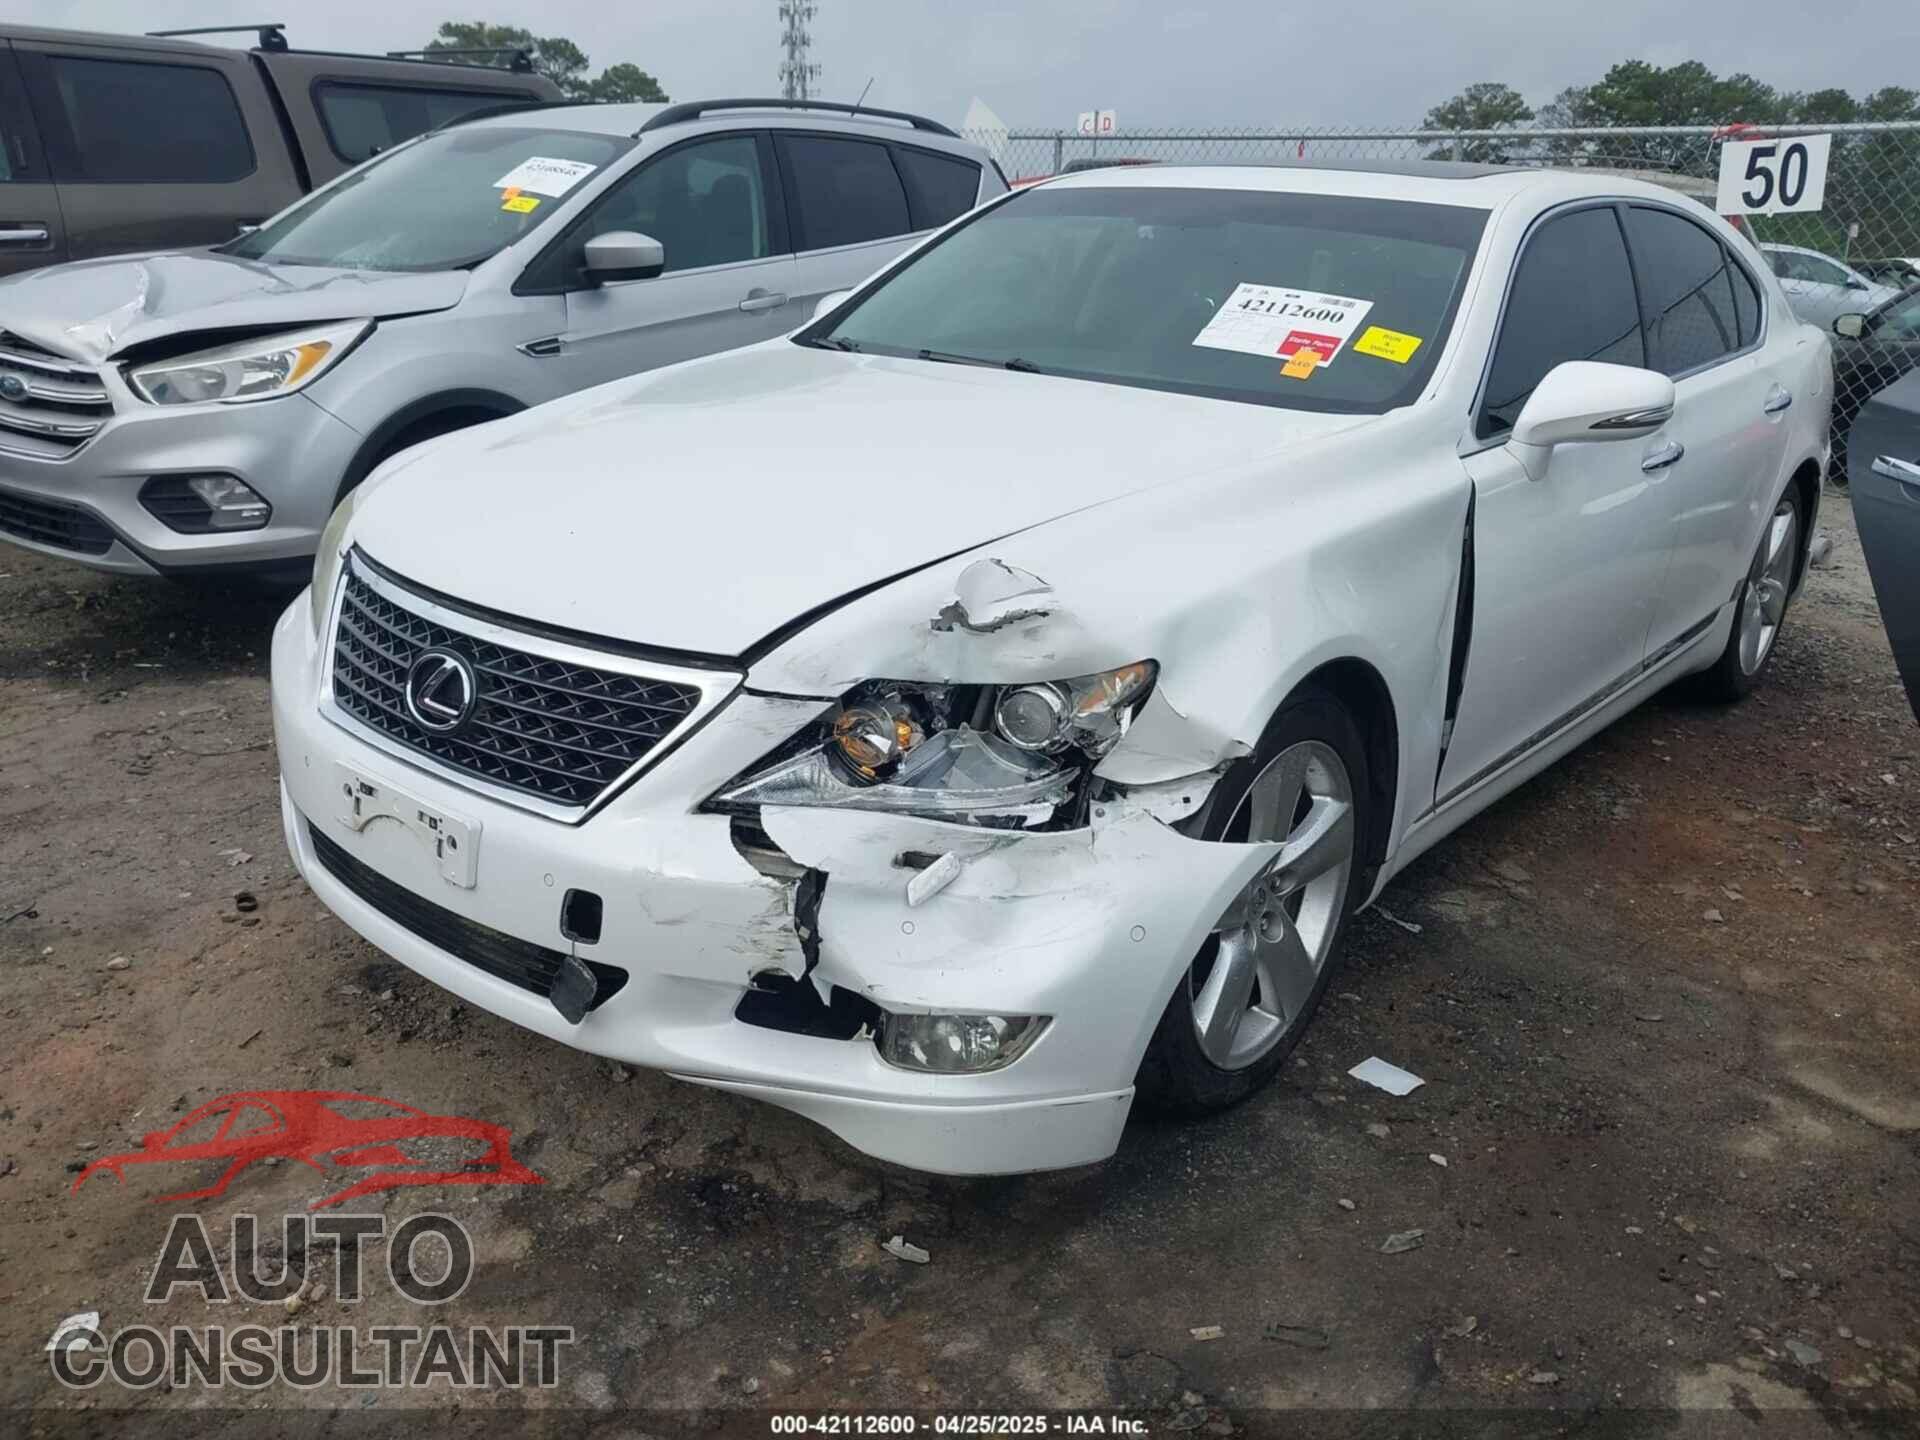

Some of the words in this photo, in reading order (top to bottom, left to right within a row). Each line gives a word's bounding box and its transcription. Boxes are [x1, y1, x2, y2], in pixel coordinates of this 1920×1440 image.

[1103, 117, 1111, 131] D
[1742, 143, 1808, 208] 50
[1237, 298, 1345, 324] 42112600
[1288, 336, 1311, 344] State
